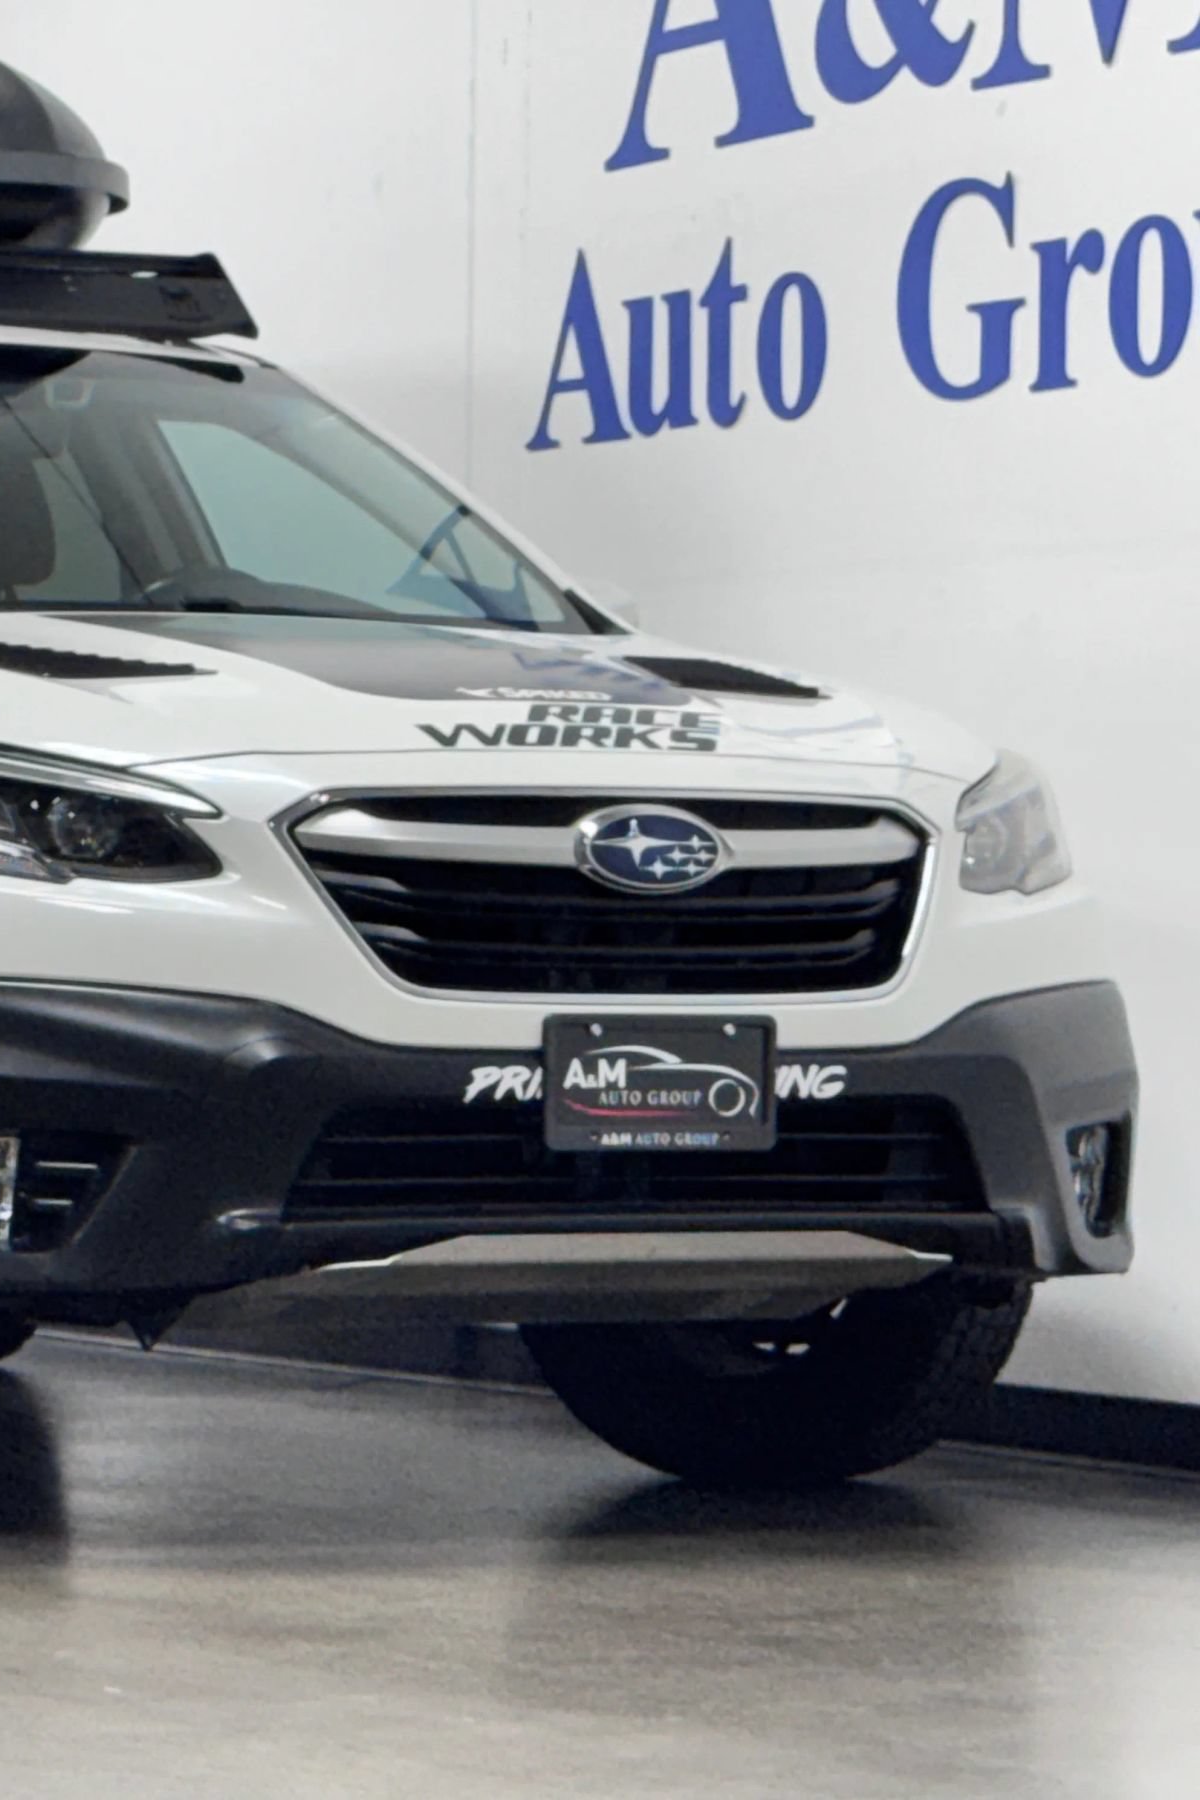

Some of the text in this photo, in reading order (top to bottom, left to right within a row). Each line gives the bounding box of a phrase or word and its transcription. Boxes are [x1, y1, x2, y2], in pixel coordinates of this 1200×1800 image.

[525, 171, 1200, 452] Auto Gro
[528, 702, 720, 729] RACE
[415, 722, 717, 752] WORKS
[462, 1063, 847, 1104] PRI ING
[562, 1057, 627, 1090] A&M
[598, 1090, 702, 1107] AUTO GROUP
[635, 1132, 671, 1146] AUTO
[674, 1132, 719, 1146] GROUP
